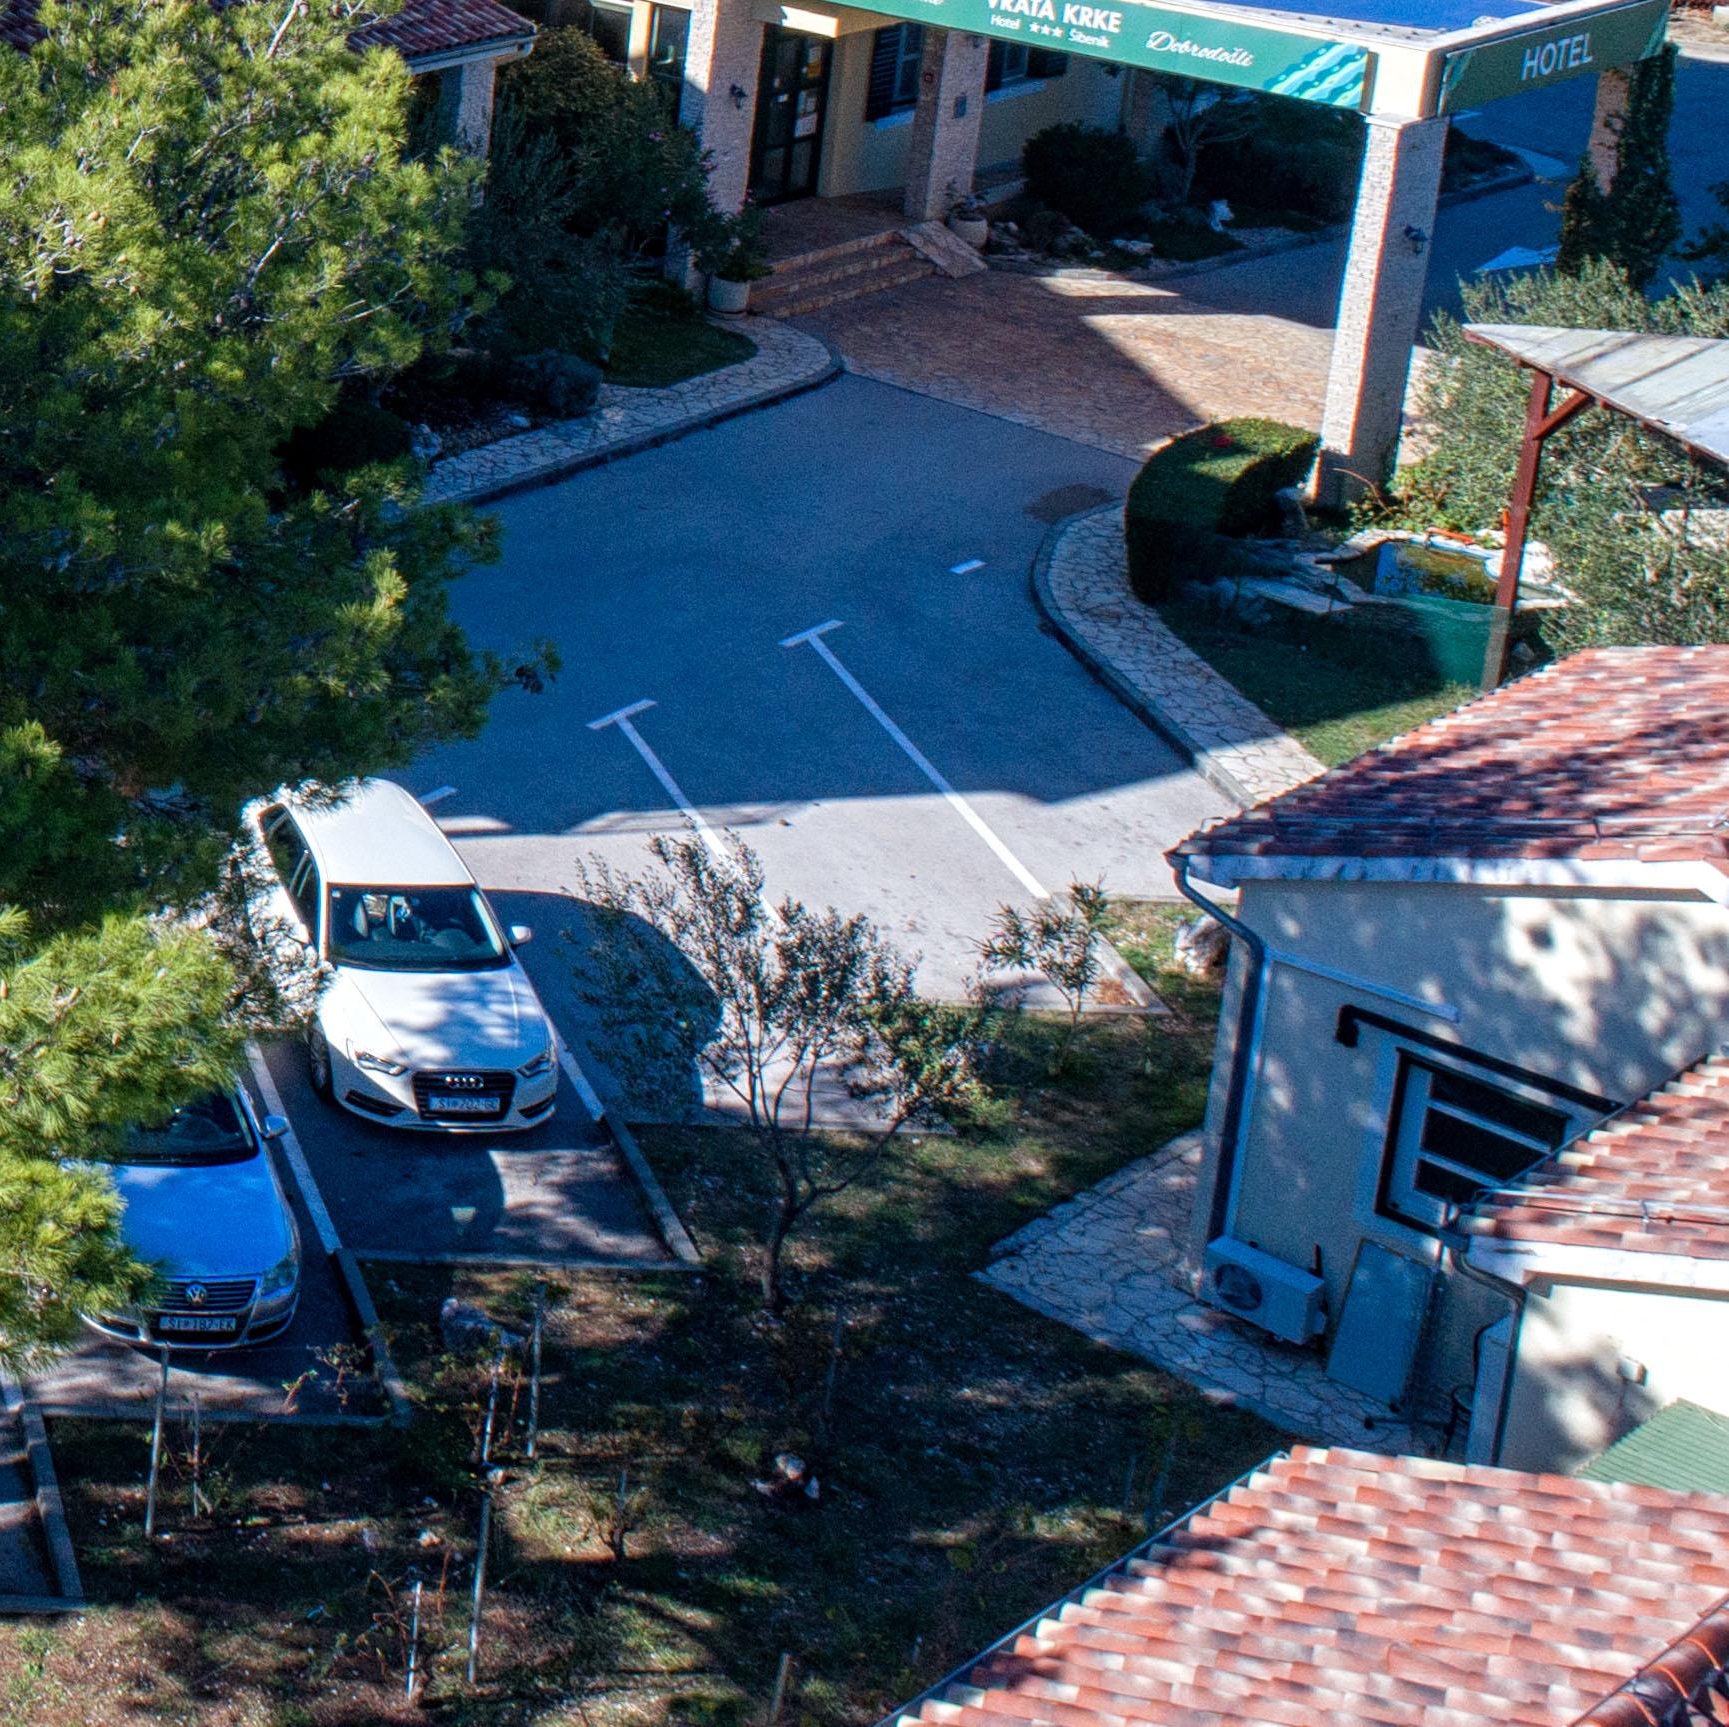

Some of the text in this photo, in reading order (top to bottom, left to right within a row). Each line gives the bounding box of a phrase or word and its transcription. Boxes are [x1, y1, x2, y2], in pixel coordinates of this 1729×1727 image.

[990, 14, 1020, 31] Hotel
[1062, 3, 1122, 34] KRKE
[1145, 31, 1254, 67] Dobrodošli
[1519, 32, 1593, 81] HOTEL
